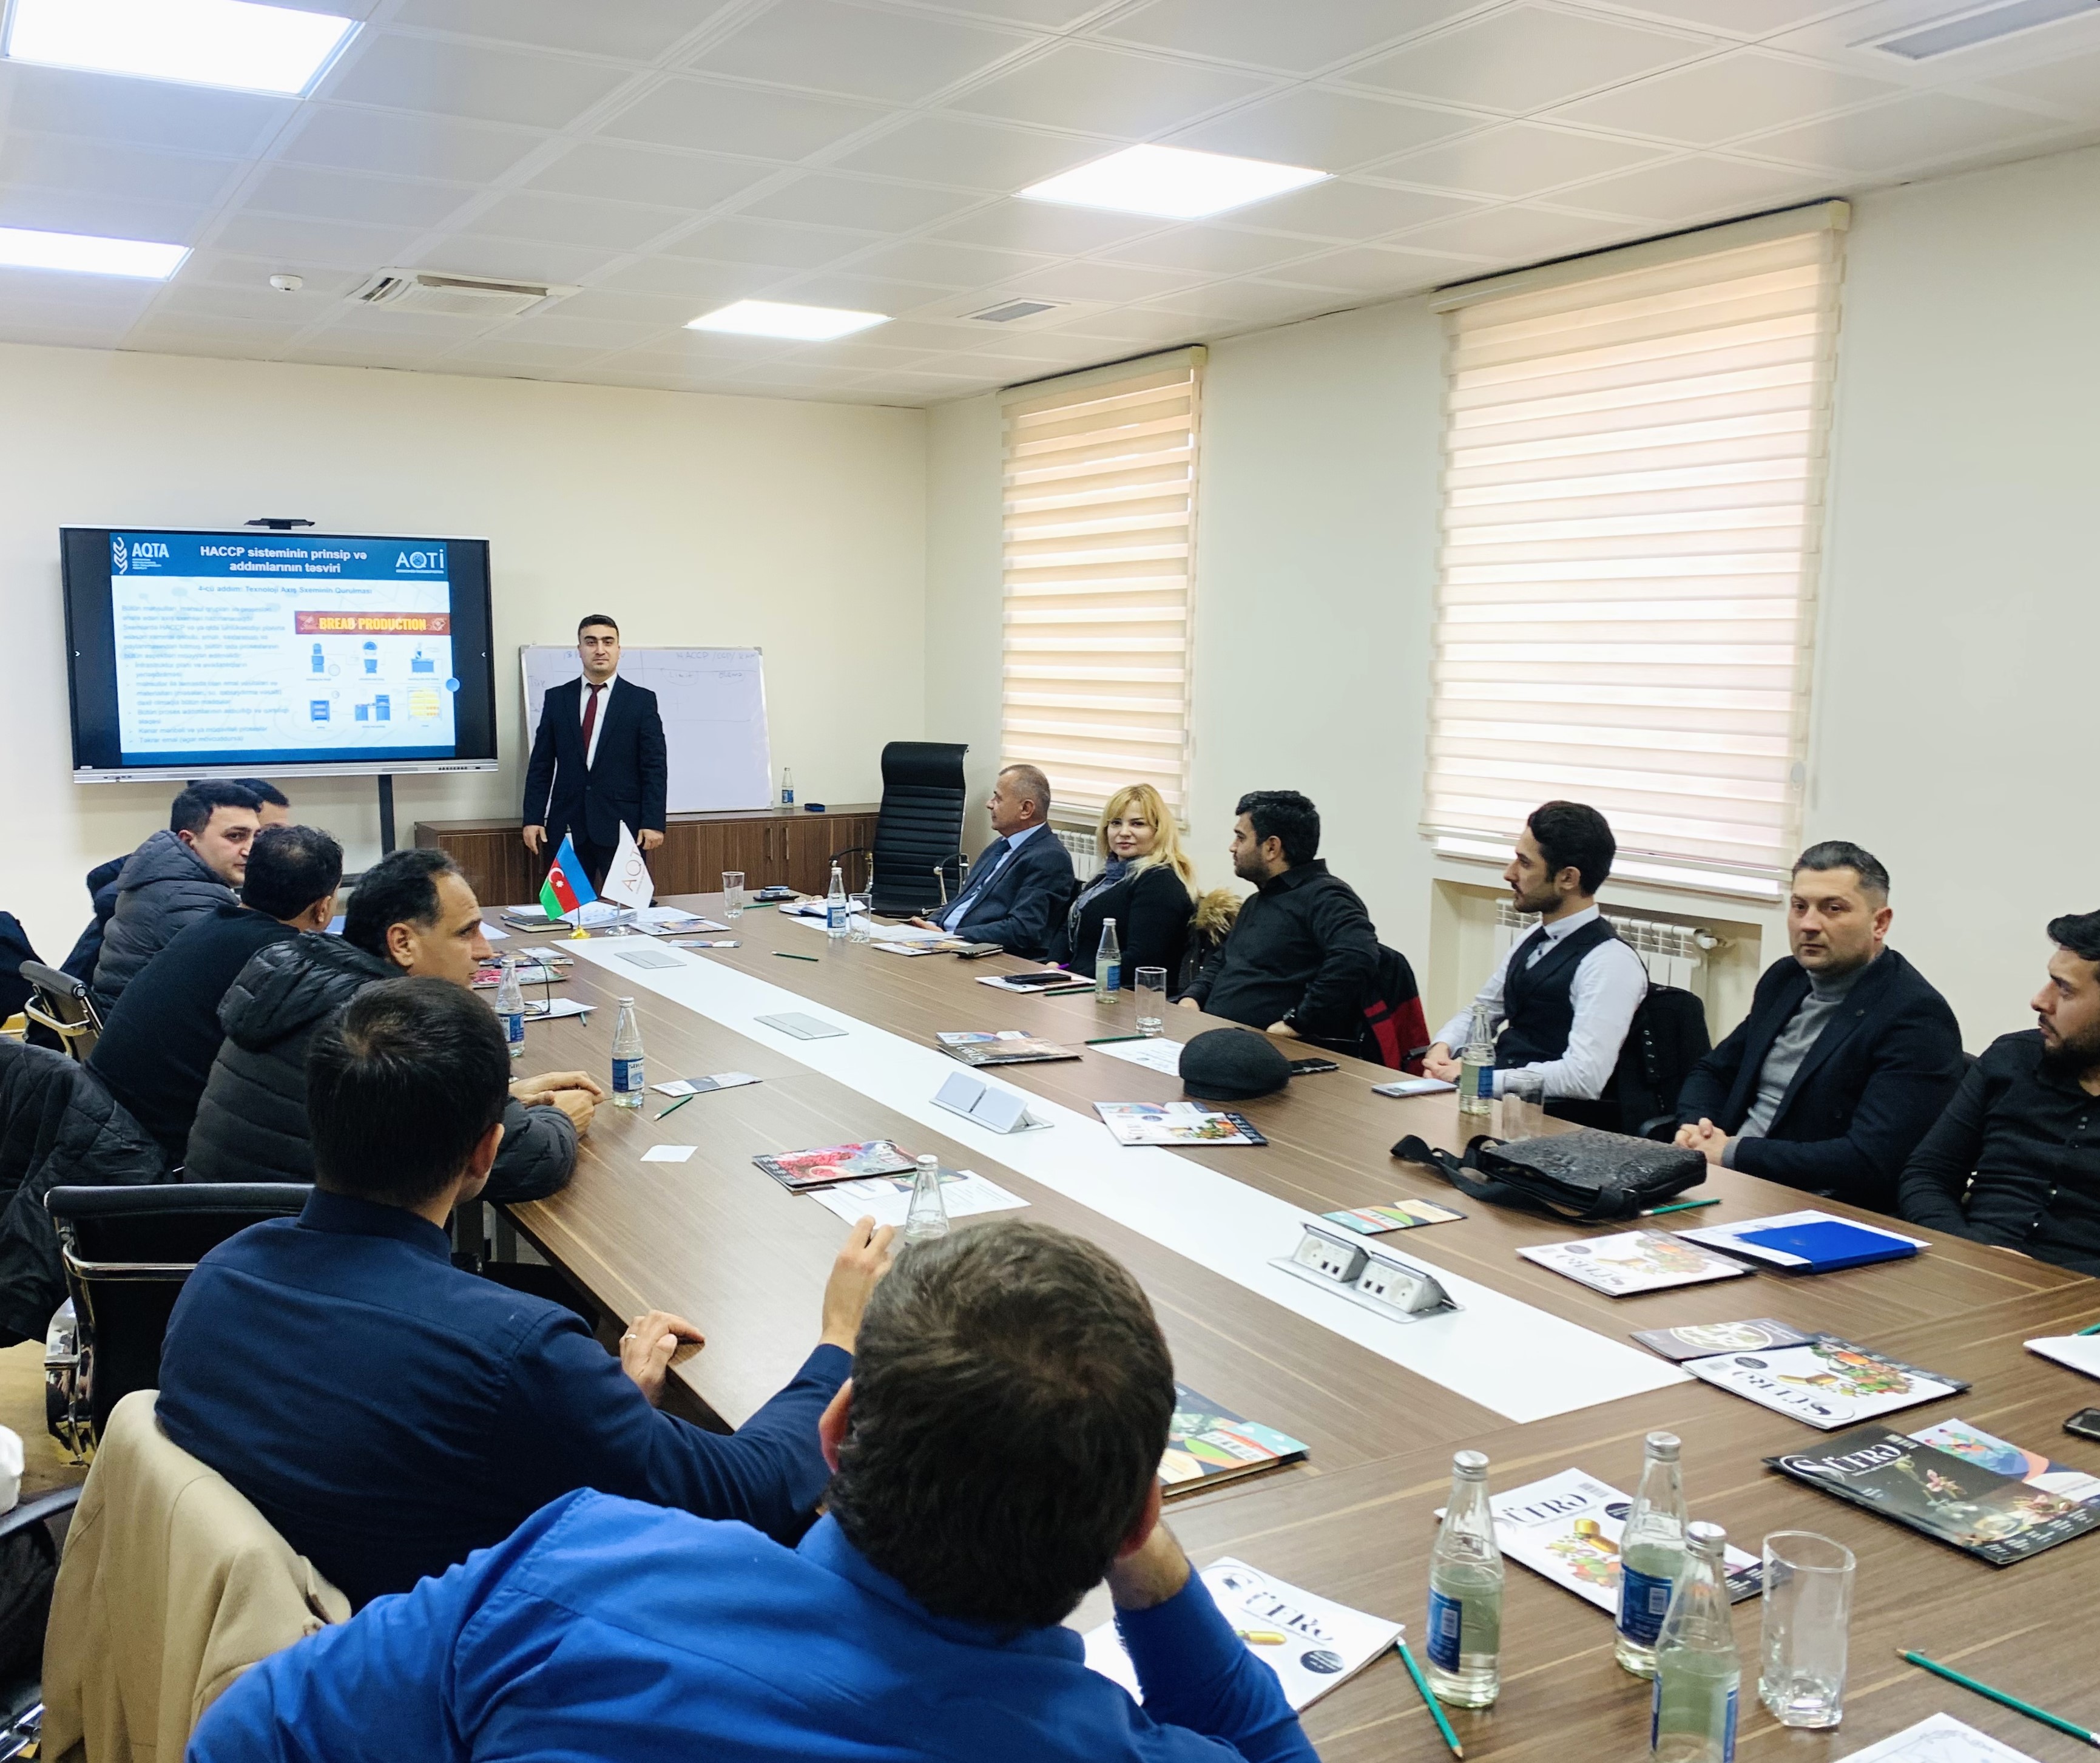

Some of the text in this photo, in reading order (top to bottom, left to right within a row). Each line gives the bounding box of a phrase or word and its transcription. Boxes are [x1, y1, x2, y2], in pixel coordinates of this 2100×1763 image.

[132, 543, 169, 558] AQTA
[200, 546, 245, 557] HACCP
[247, 547, 308, 558] sisteminin
[311, 549, 351, 561] prinsip
[396, 549, 444, 569] AQTİ
[229, 561, 341, 573] addımlarının təsviri
[319, 617, 427, 631] BREAD PRODUCTION
[1780, 1444, 1902, 1482] SÜFRƏ
